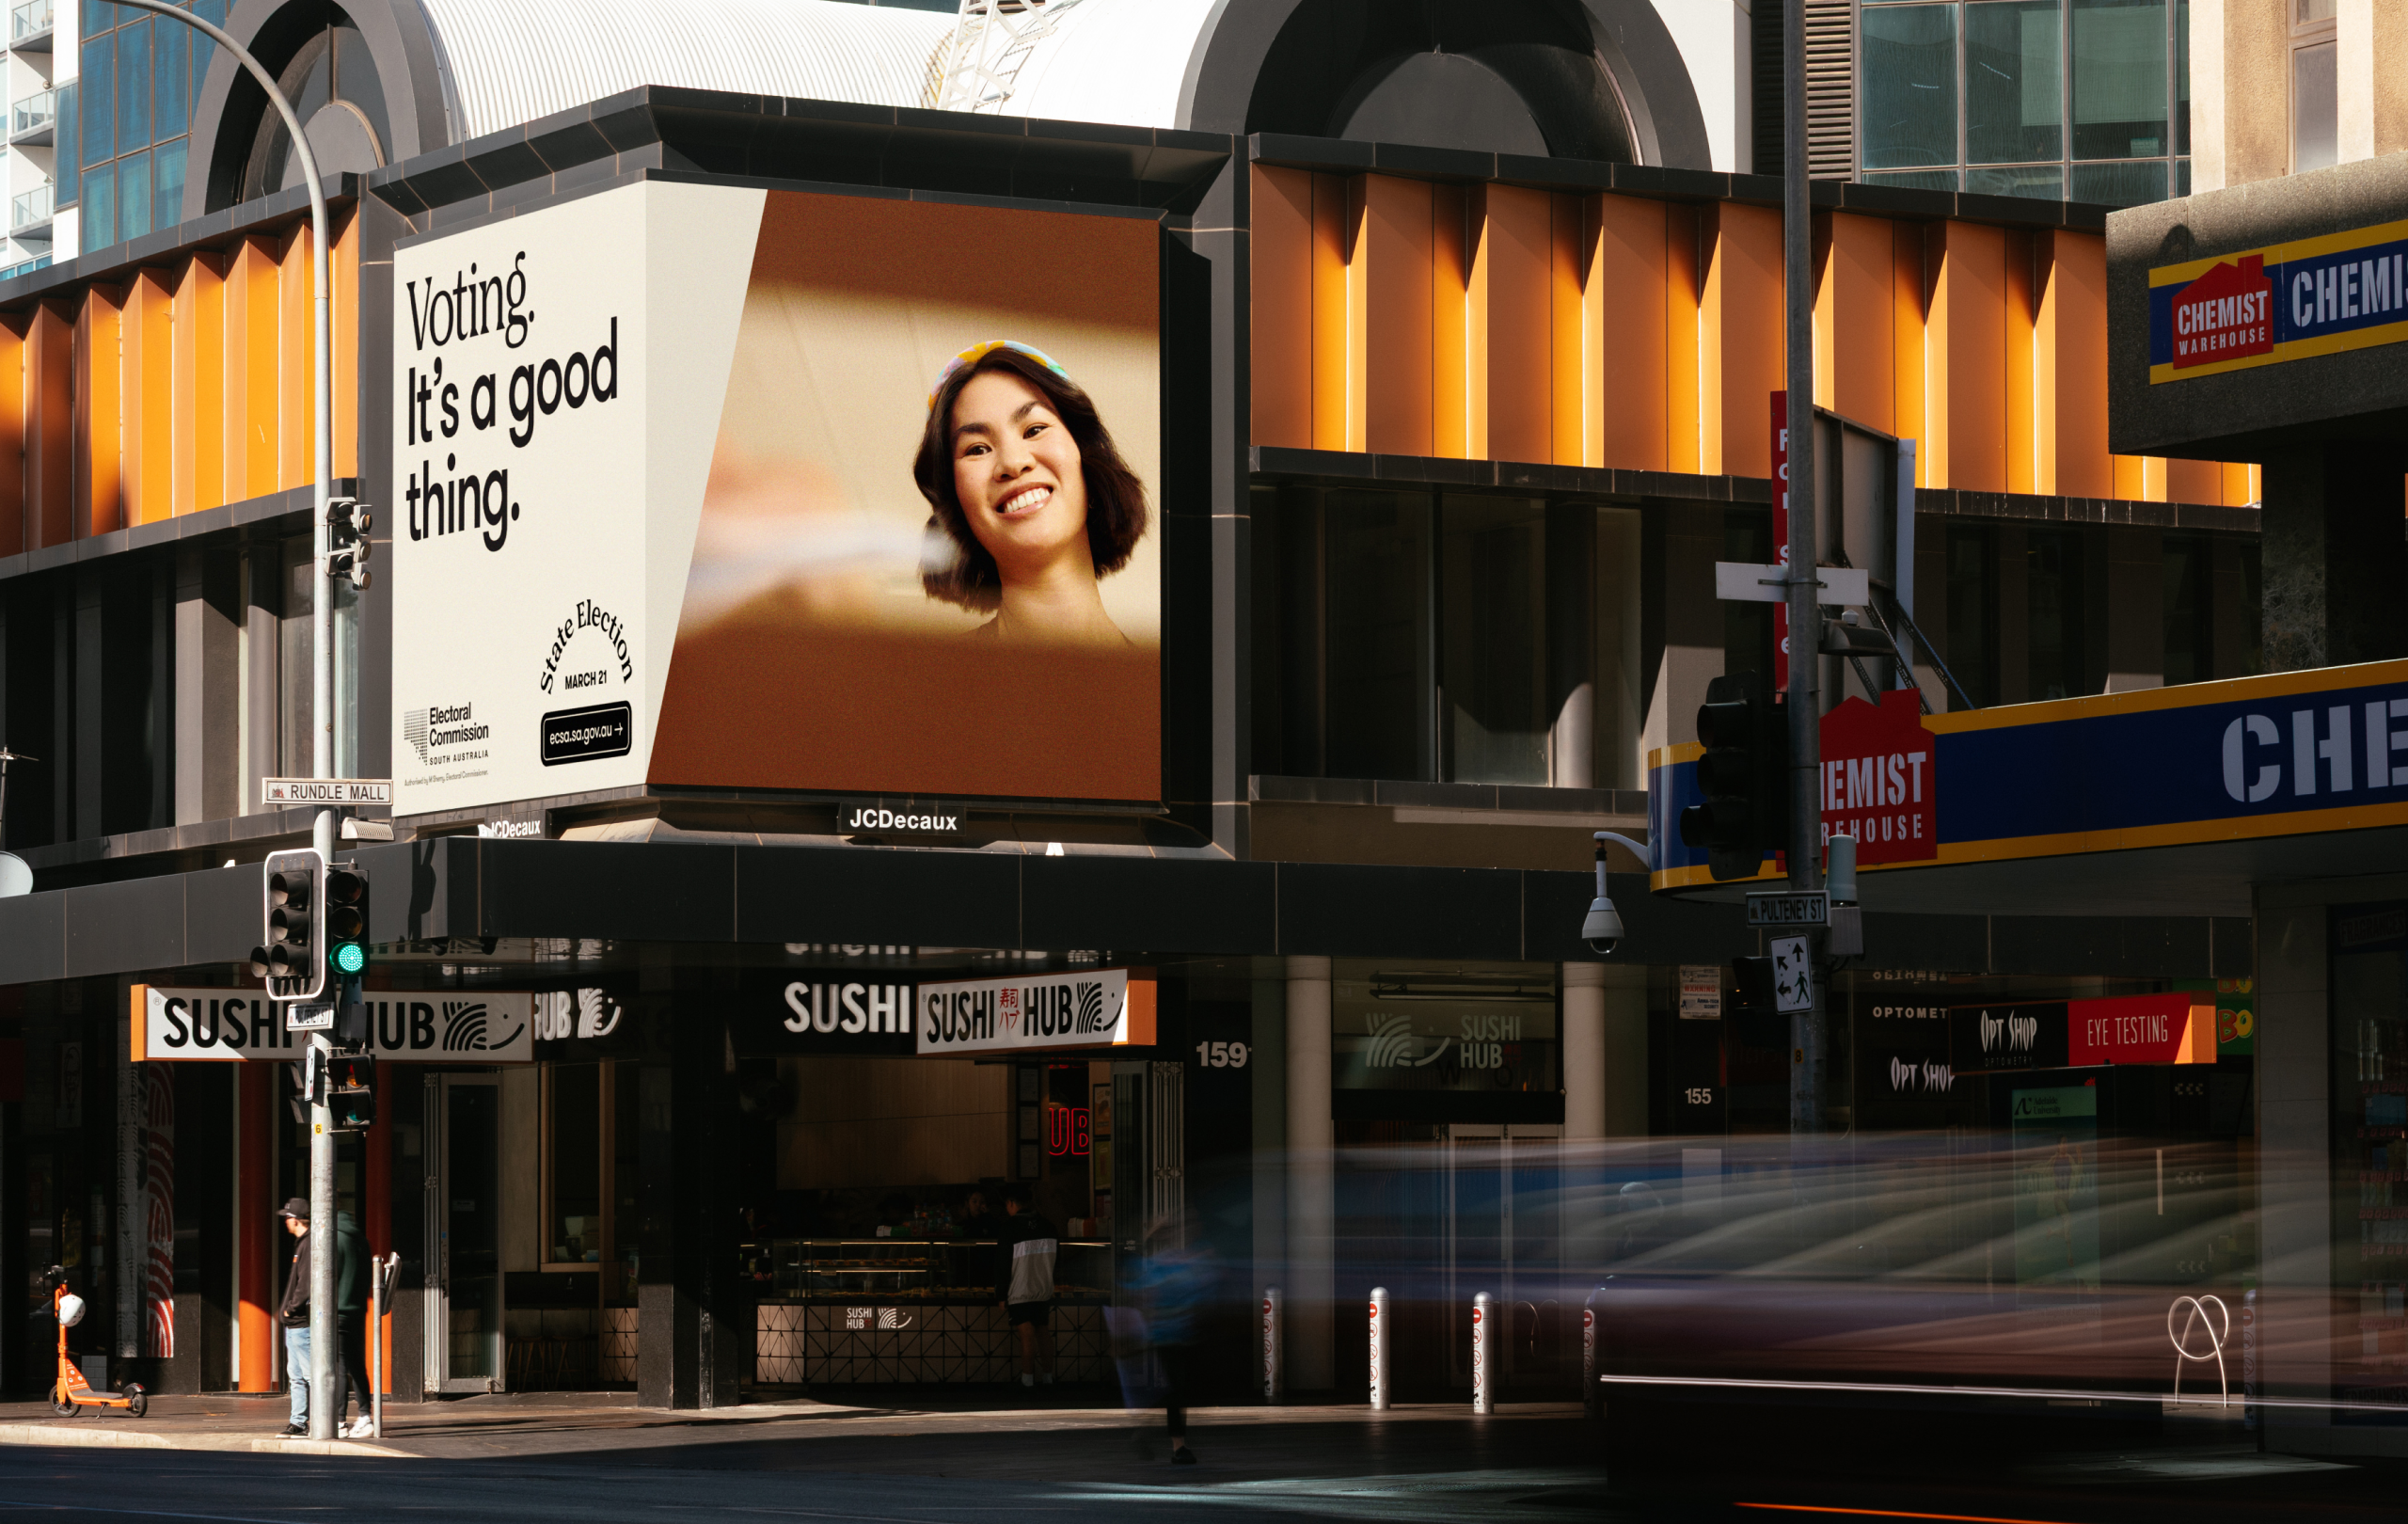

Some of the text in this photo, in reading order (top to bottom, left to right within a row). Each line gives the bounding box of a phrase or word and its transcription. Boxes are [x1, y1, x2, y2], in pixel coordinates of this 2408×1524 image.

[406, 250, 535, 349] Voting.
[2292, 254, 2408, 327] CHEMI
[2178, 290, 2268, 336] CHEMIST
[2178, 326, 2266, 356] WAREHOUSE
[470, 373, 496, 431] a
[509, 316, 618, 449] good
[405, 452, 520, 552] thing.
[540, 598, 633, 695] State Election
[565, 669, 608, 690] MARCH 21
[430, 701, 471, 725] Electoral
[429, 722, 489, 747] Commission
[549, 723, 612, 746] ecsa.sa.gov.au
[429, 749, 489, 766] SOUTH AUSTRALIA
[2222, 698, 2408, 802] CHE
[291, 785, 385, 801] RUNDLE MALL
[1820, 752, 1926, 811] EMIST
[849, 808, 958, 831] JCDecaux
[1761, 898, 1822, 921] PULTENEY ST
[1000, 987, 1019, 1008] 寿司
[1684, 984, 1716, 992] WARNING
[784, 981, 911, 1034] SUSHI
[927, 985, 1073, 1043] SUSHI HUB
[164, 997, 293, 1049] SUSHI
[1460, 1014, 1521, 1040] SUSHI
[2087, 1015, 2168, 1046] EYE TESTING
[2217, 1008, 2253, 1044] BO
[1196, 1040, 1248, 1069] 159
[1460, 1042, 1503, 1069] HUB
[1795, 1049, 1802, 1063] 8
[1685, 1087, 1712, 1104] 155
[2033, 1096, 2058, 1105] Adelaide
[2033, 1104, 2061, 1117] University
[315, 1124, 322, 1134] 6
[1048, 1107, 1089, 1156] UB
[847, 1307, 873, 1319] SUSHI
[847, 1318, 864, 1329] HUB
